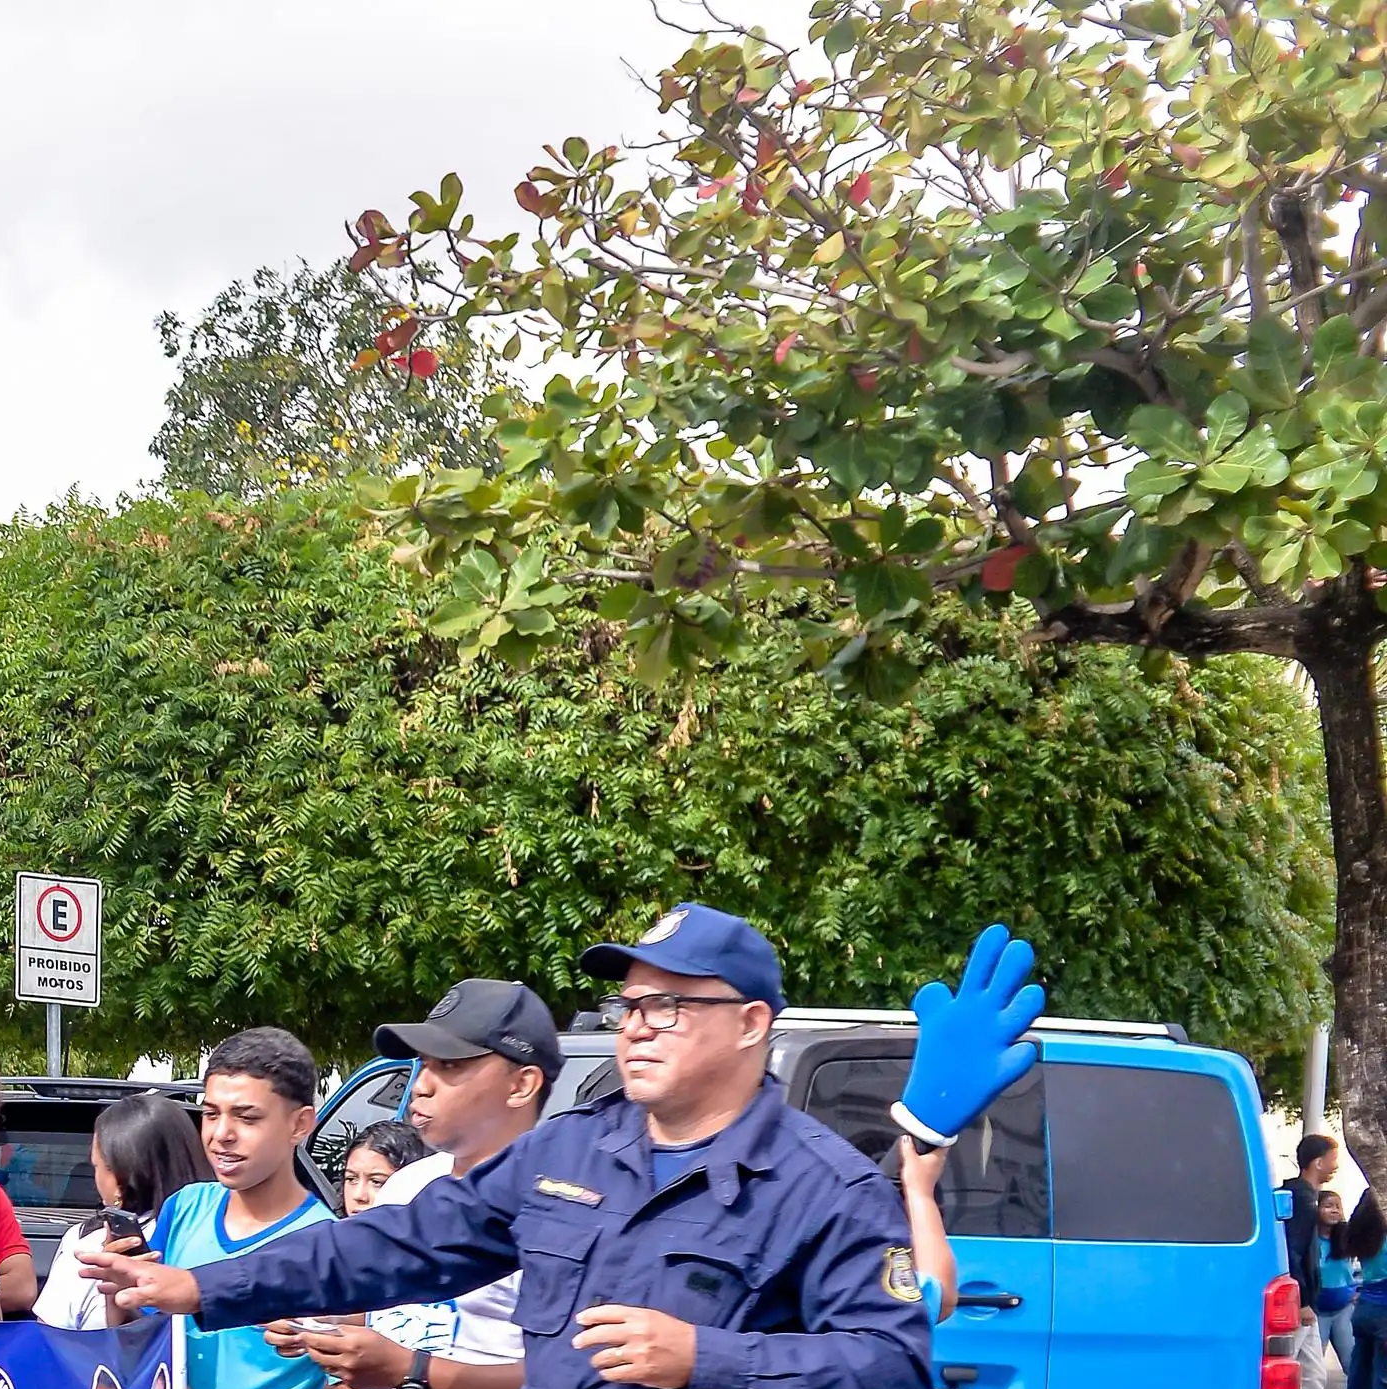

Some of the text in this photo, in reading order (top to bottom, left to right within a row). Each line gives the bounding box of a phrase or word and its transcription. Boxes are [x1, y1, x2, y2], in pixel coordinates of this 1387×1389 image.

[53, 899, 68, 931] E
[28, 956, 91, 974] PROIBIDO
[37, 976, 84, 991] MOTOS
